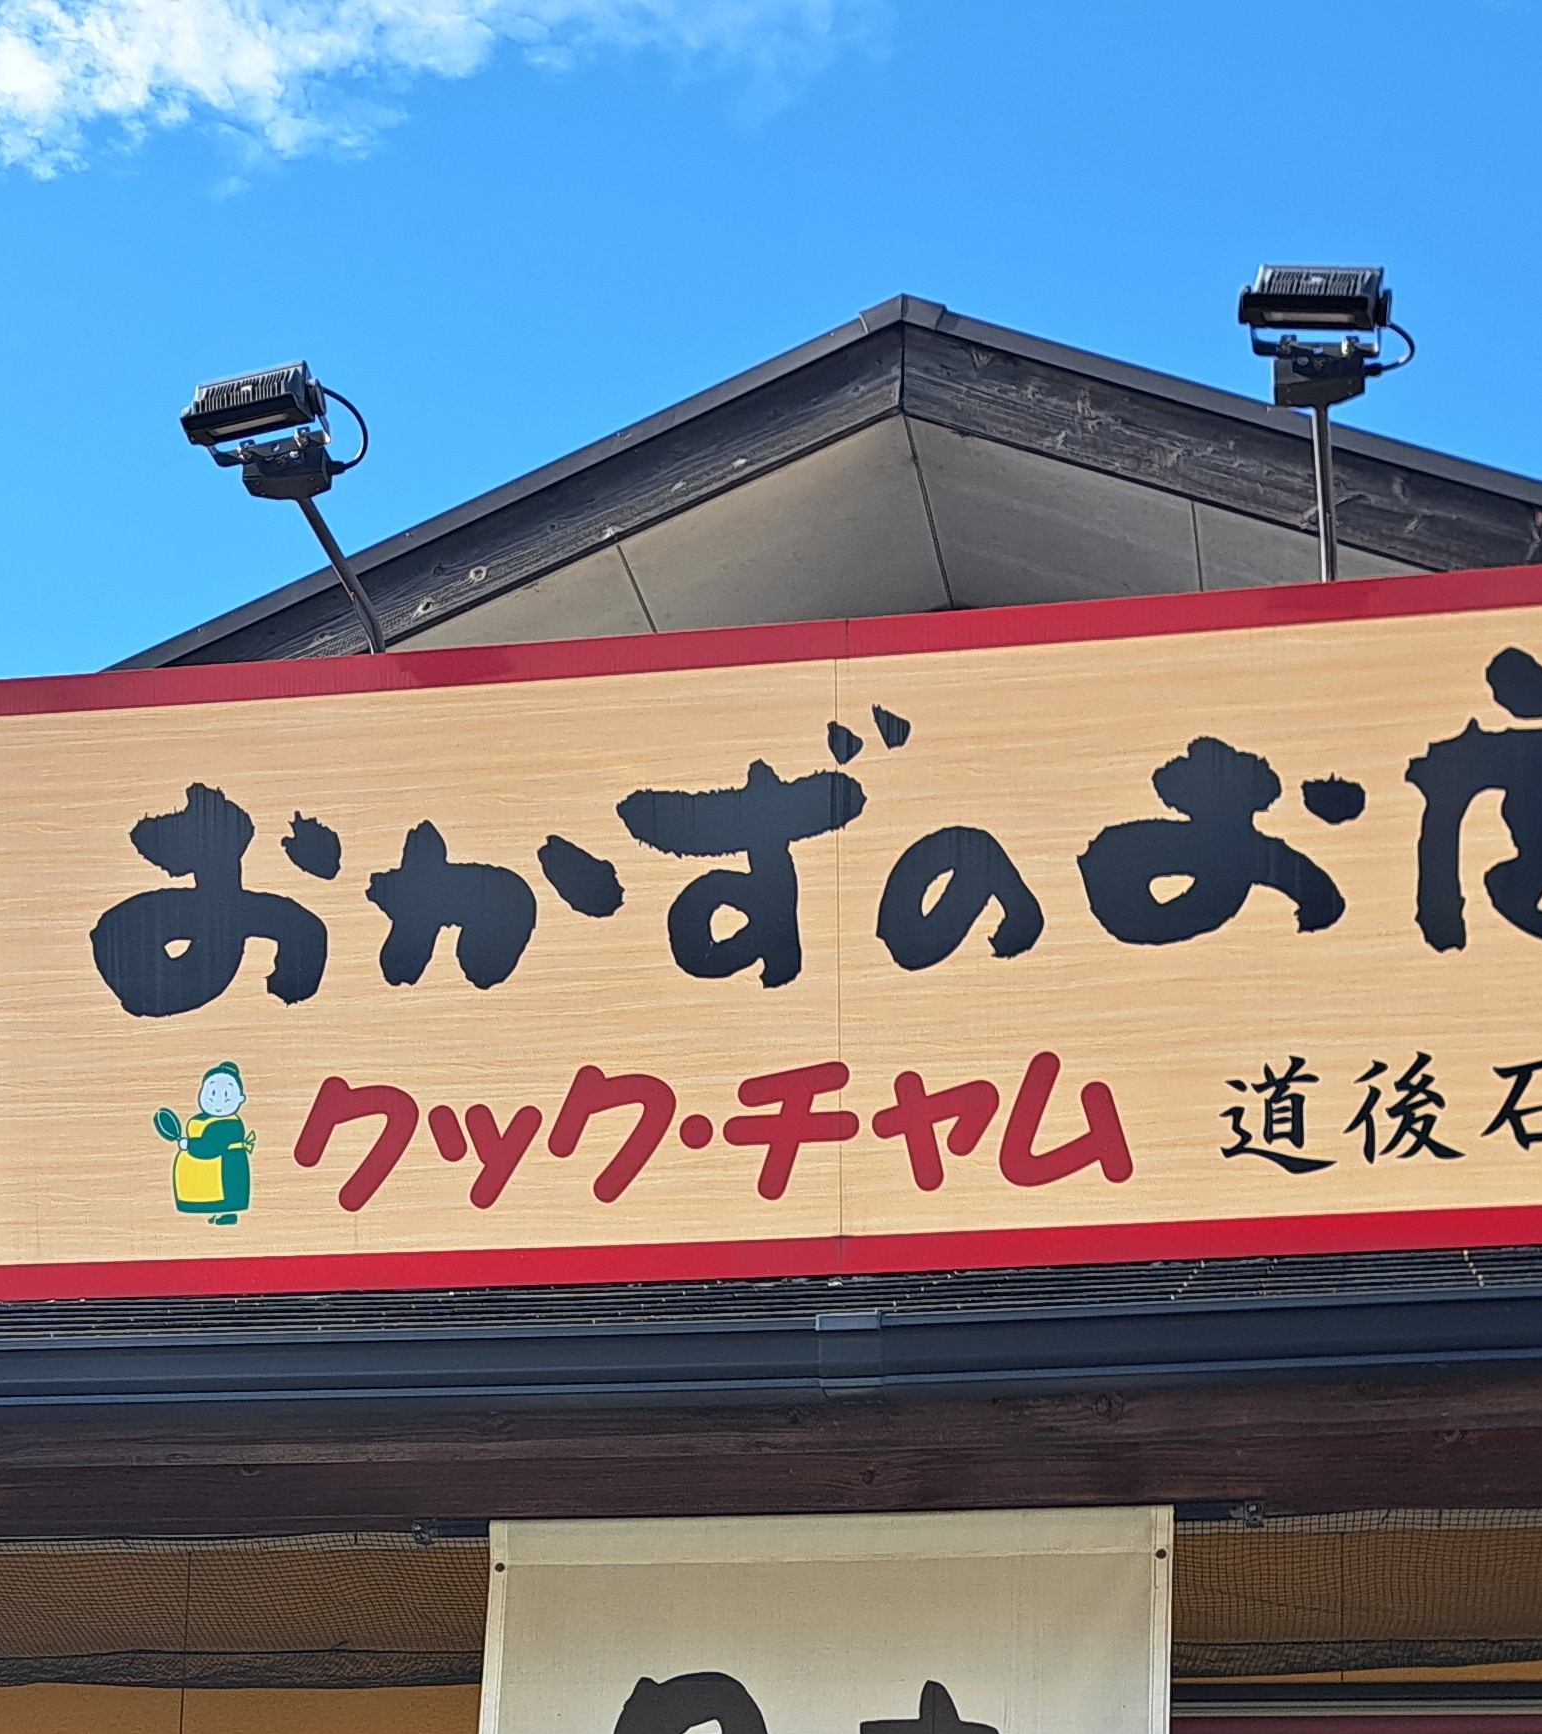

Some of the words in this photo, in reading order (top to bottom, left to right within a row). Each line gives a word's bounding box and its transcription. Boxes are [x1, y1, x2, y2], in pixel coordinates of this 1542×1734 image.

[293, 1050, 1136, 1212] クック・チャム
